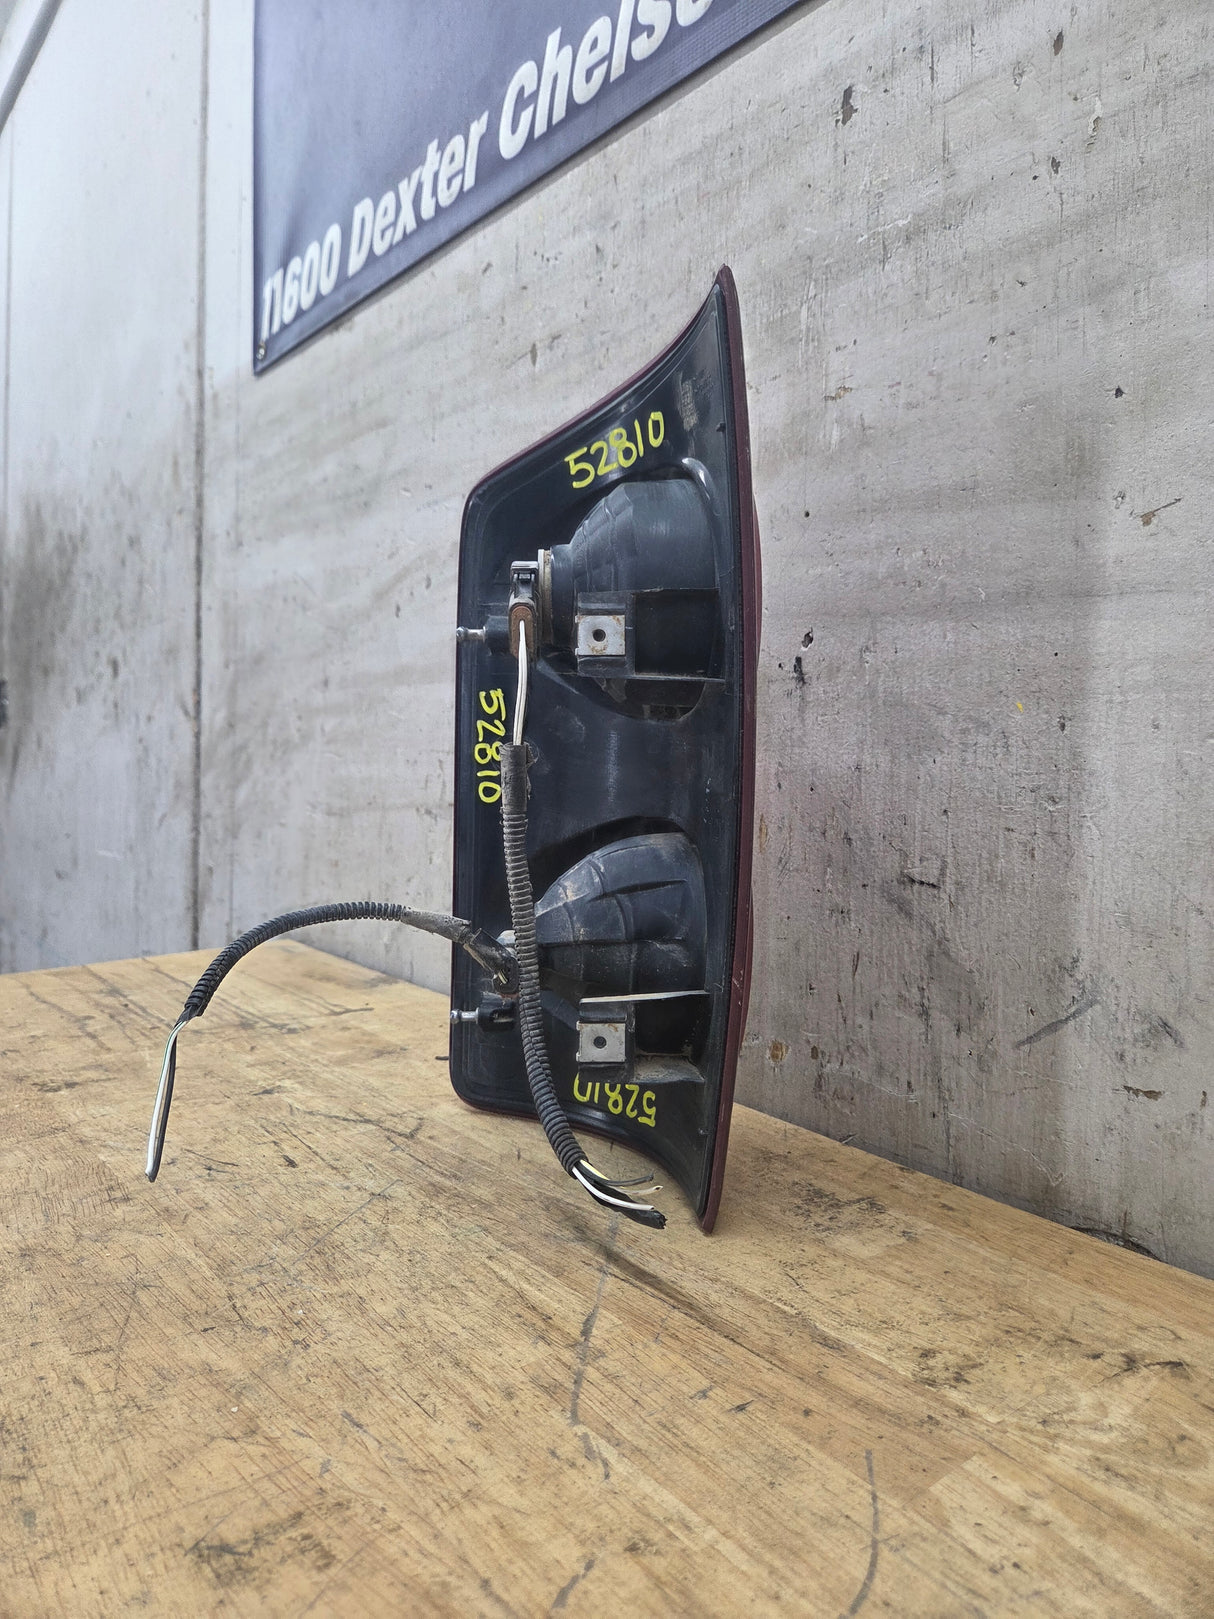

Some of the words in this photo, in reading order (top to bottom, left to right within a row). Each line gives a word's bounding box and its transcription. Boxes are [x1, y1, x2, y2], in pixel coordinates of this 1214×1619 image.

[261, 222, 342, 341] 11600
[347, 110, 489, 279] Dexter
[499, 0, 714, 160] Chels
[564, 411, 665, 488] 52810
[474, 688, 506, 803] 52810
